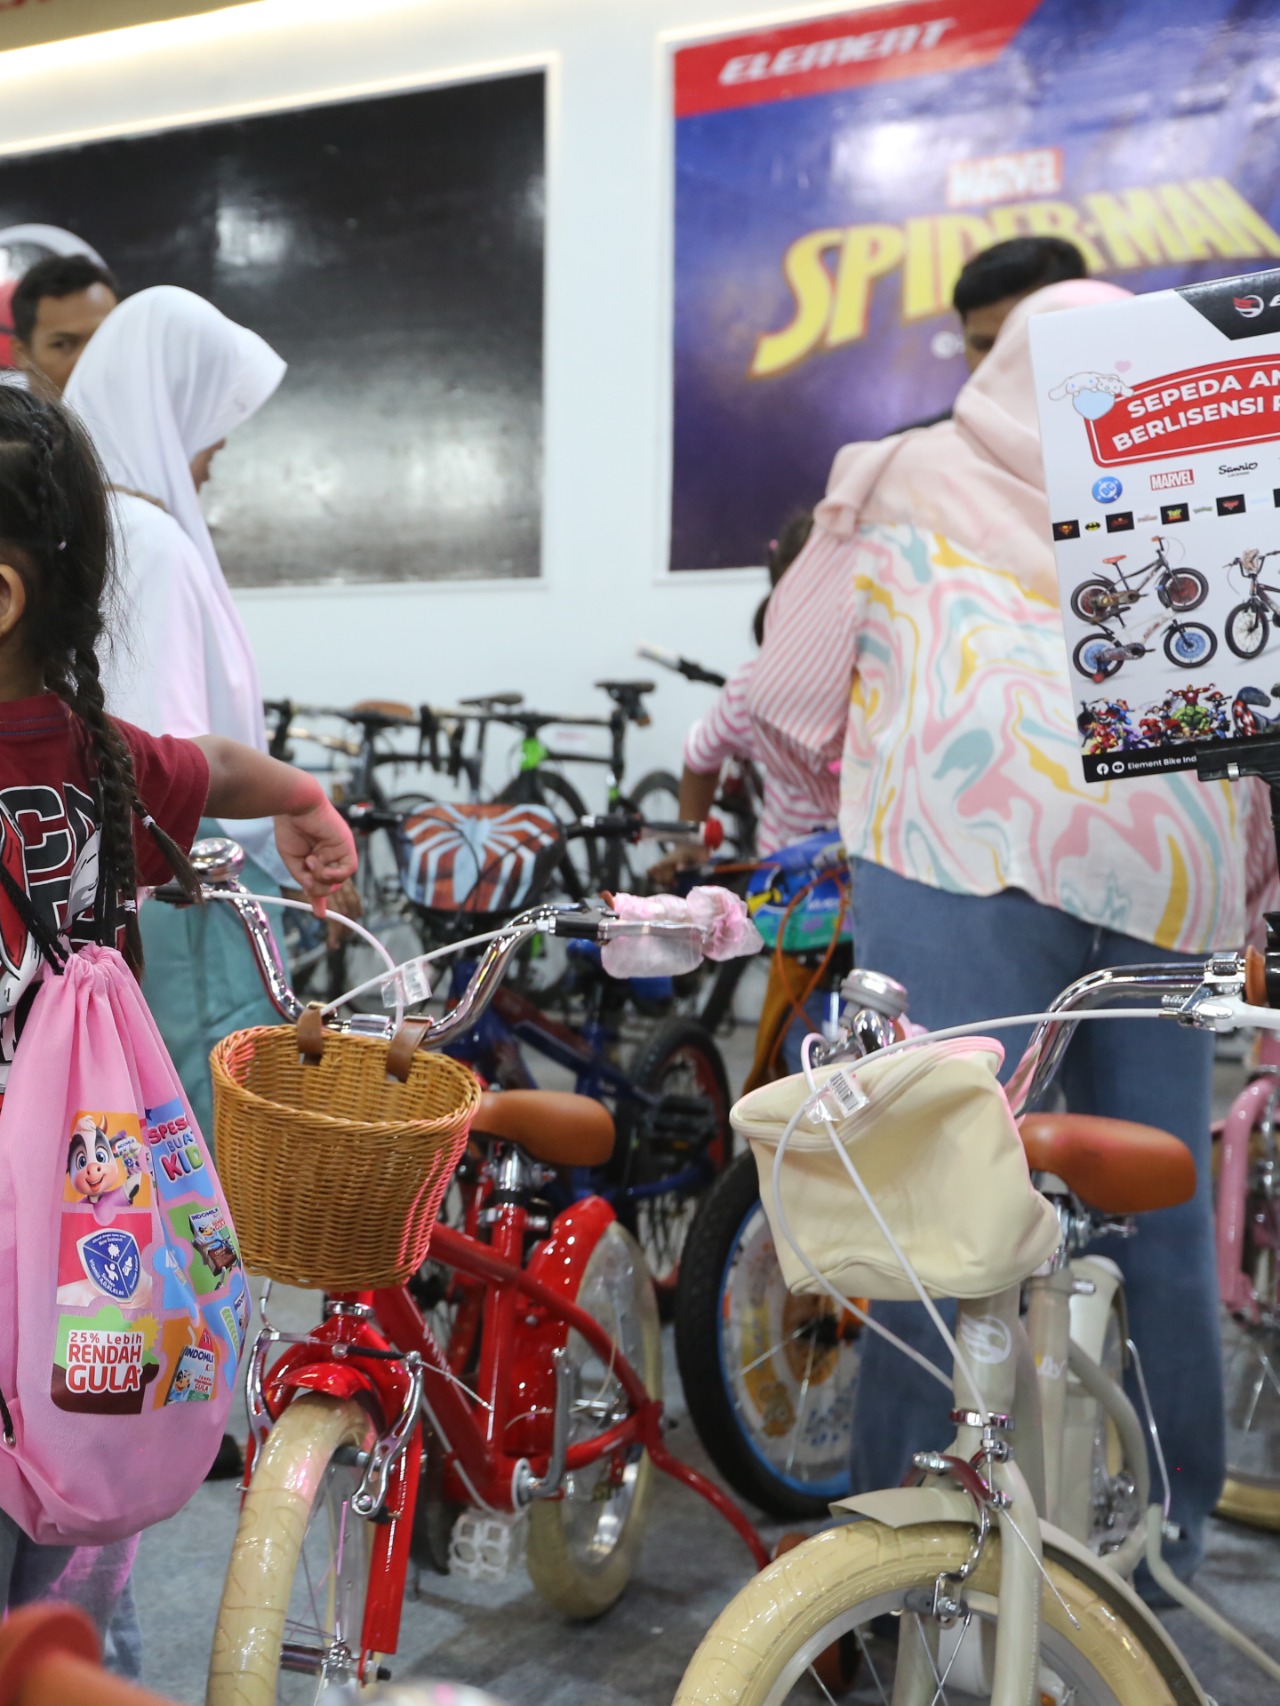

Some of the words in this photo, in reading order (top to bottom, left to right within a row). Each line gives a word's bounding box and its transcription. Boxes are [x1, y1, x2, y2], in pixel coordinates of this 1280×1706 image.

[719, 16, 957, 86] ELEMENT
[1127, 375, 1242, 418] SEPEDA
[1112, 397, 1265, 451] BERLISENSI
[1218, 462, 1258, 475] Sanrio
[1151, 471, 1194, 490] MARVEL
[1127, 760, 1162, 770] Element
[1163, 757, 1181, 766] Bike
[70, 1332, 100, 1344] 25%
[106, 1334, 143, 1345] Lebih
[69, 1344, 141, 1364] RENDAH
